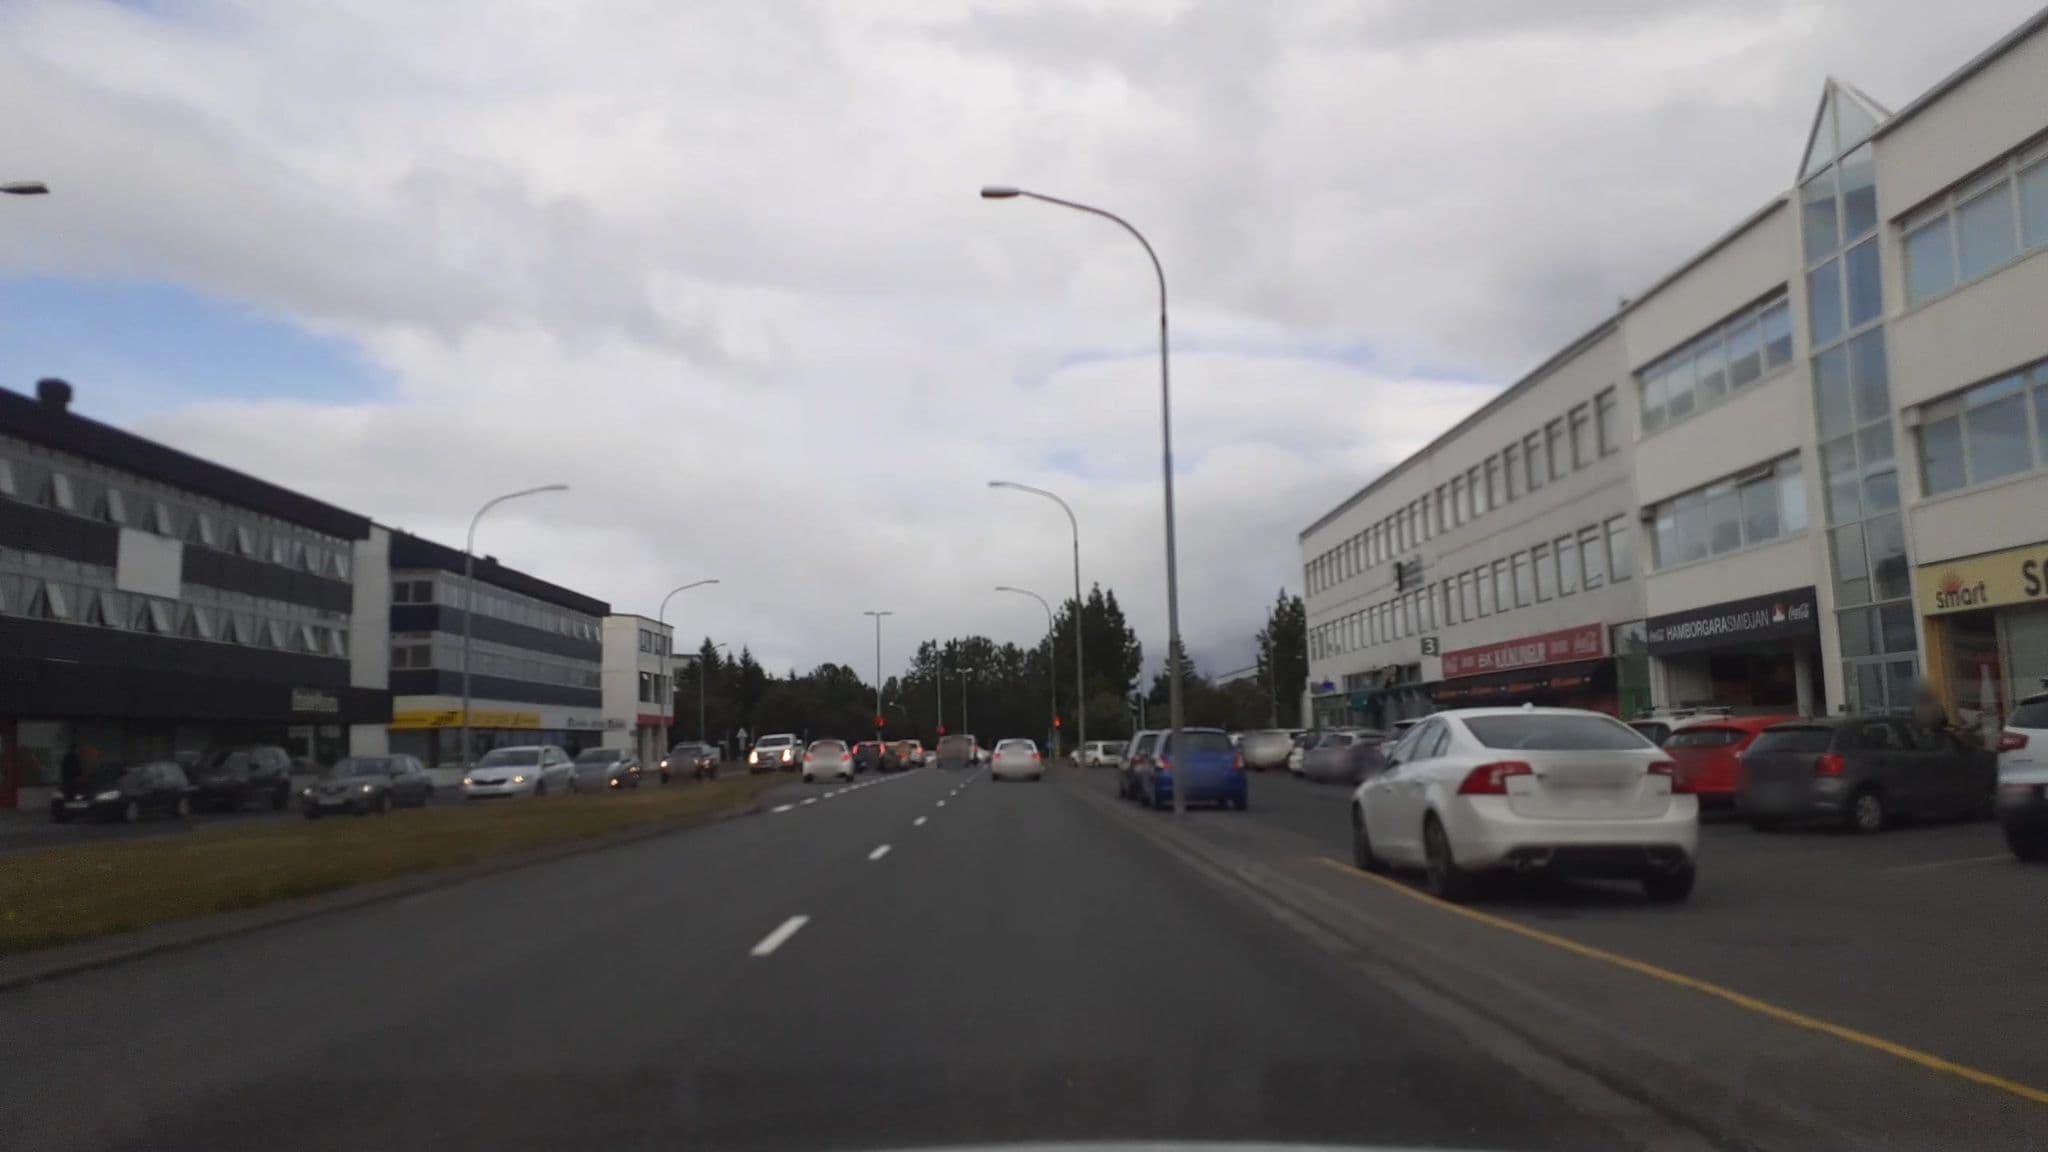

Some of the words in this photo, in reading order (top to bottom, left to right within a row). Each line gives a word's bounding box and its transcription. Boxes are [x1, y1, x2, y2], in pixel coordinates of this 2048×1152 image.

[2022, 557, 2048, 598] S
[1936, 580, 1988, 609] smart
[1424, 639, 1434, 653] 3
